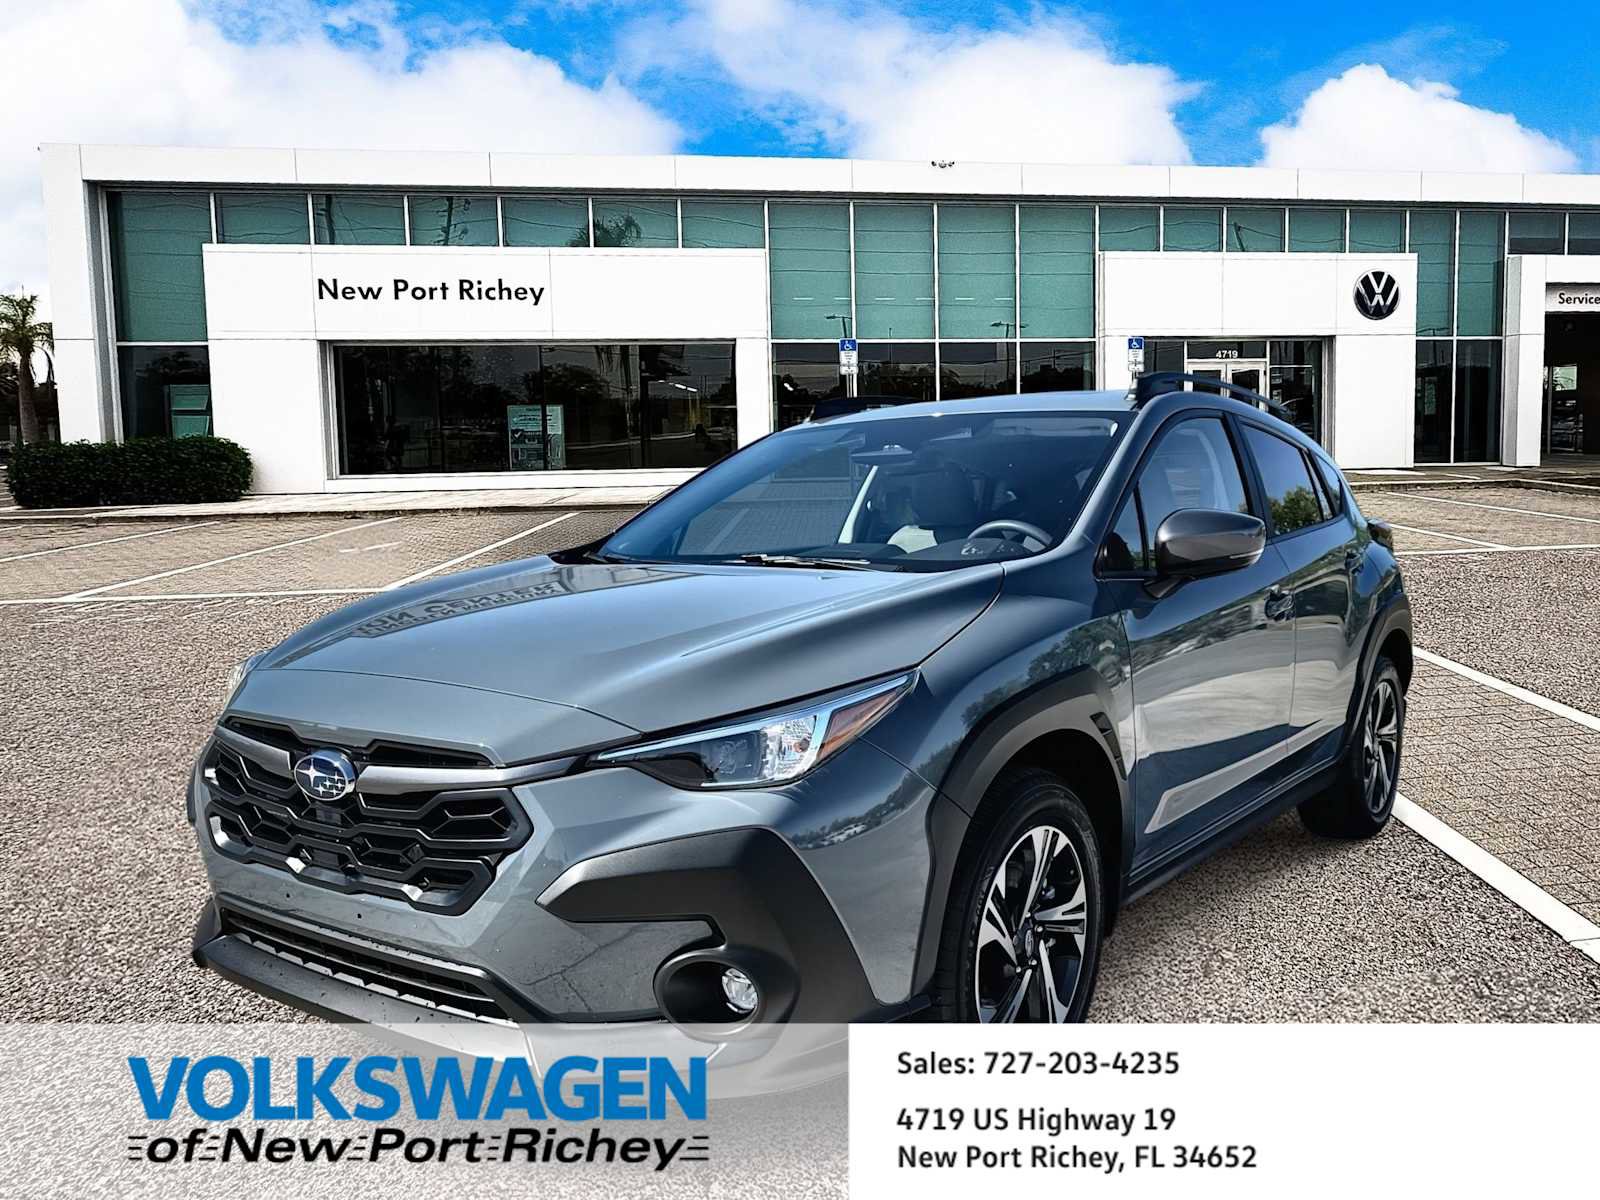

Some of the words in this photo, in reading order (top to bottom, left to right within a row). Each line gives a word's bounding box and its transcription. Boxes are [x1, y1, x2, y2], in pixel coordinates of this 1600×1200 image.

[317, 278, 383, 301] New
[393, 278, 449, 301] Port
[458, 278, 545, 306] Richey
[1558, 292, 1600, 305] Service
[1215, 350, 1239, 359] 4719
